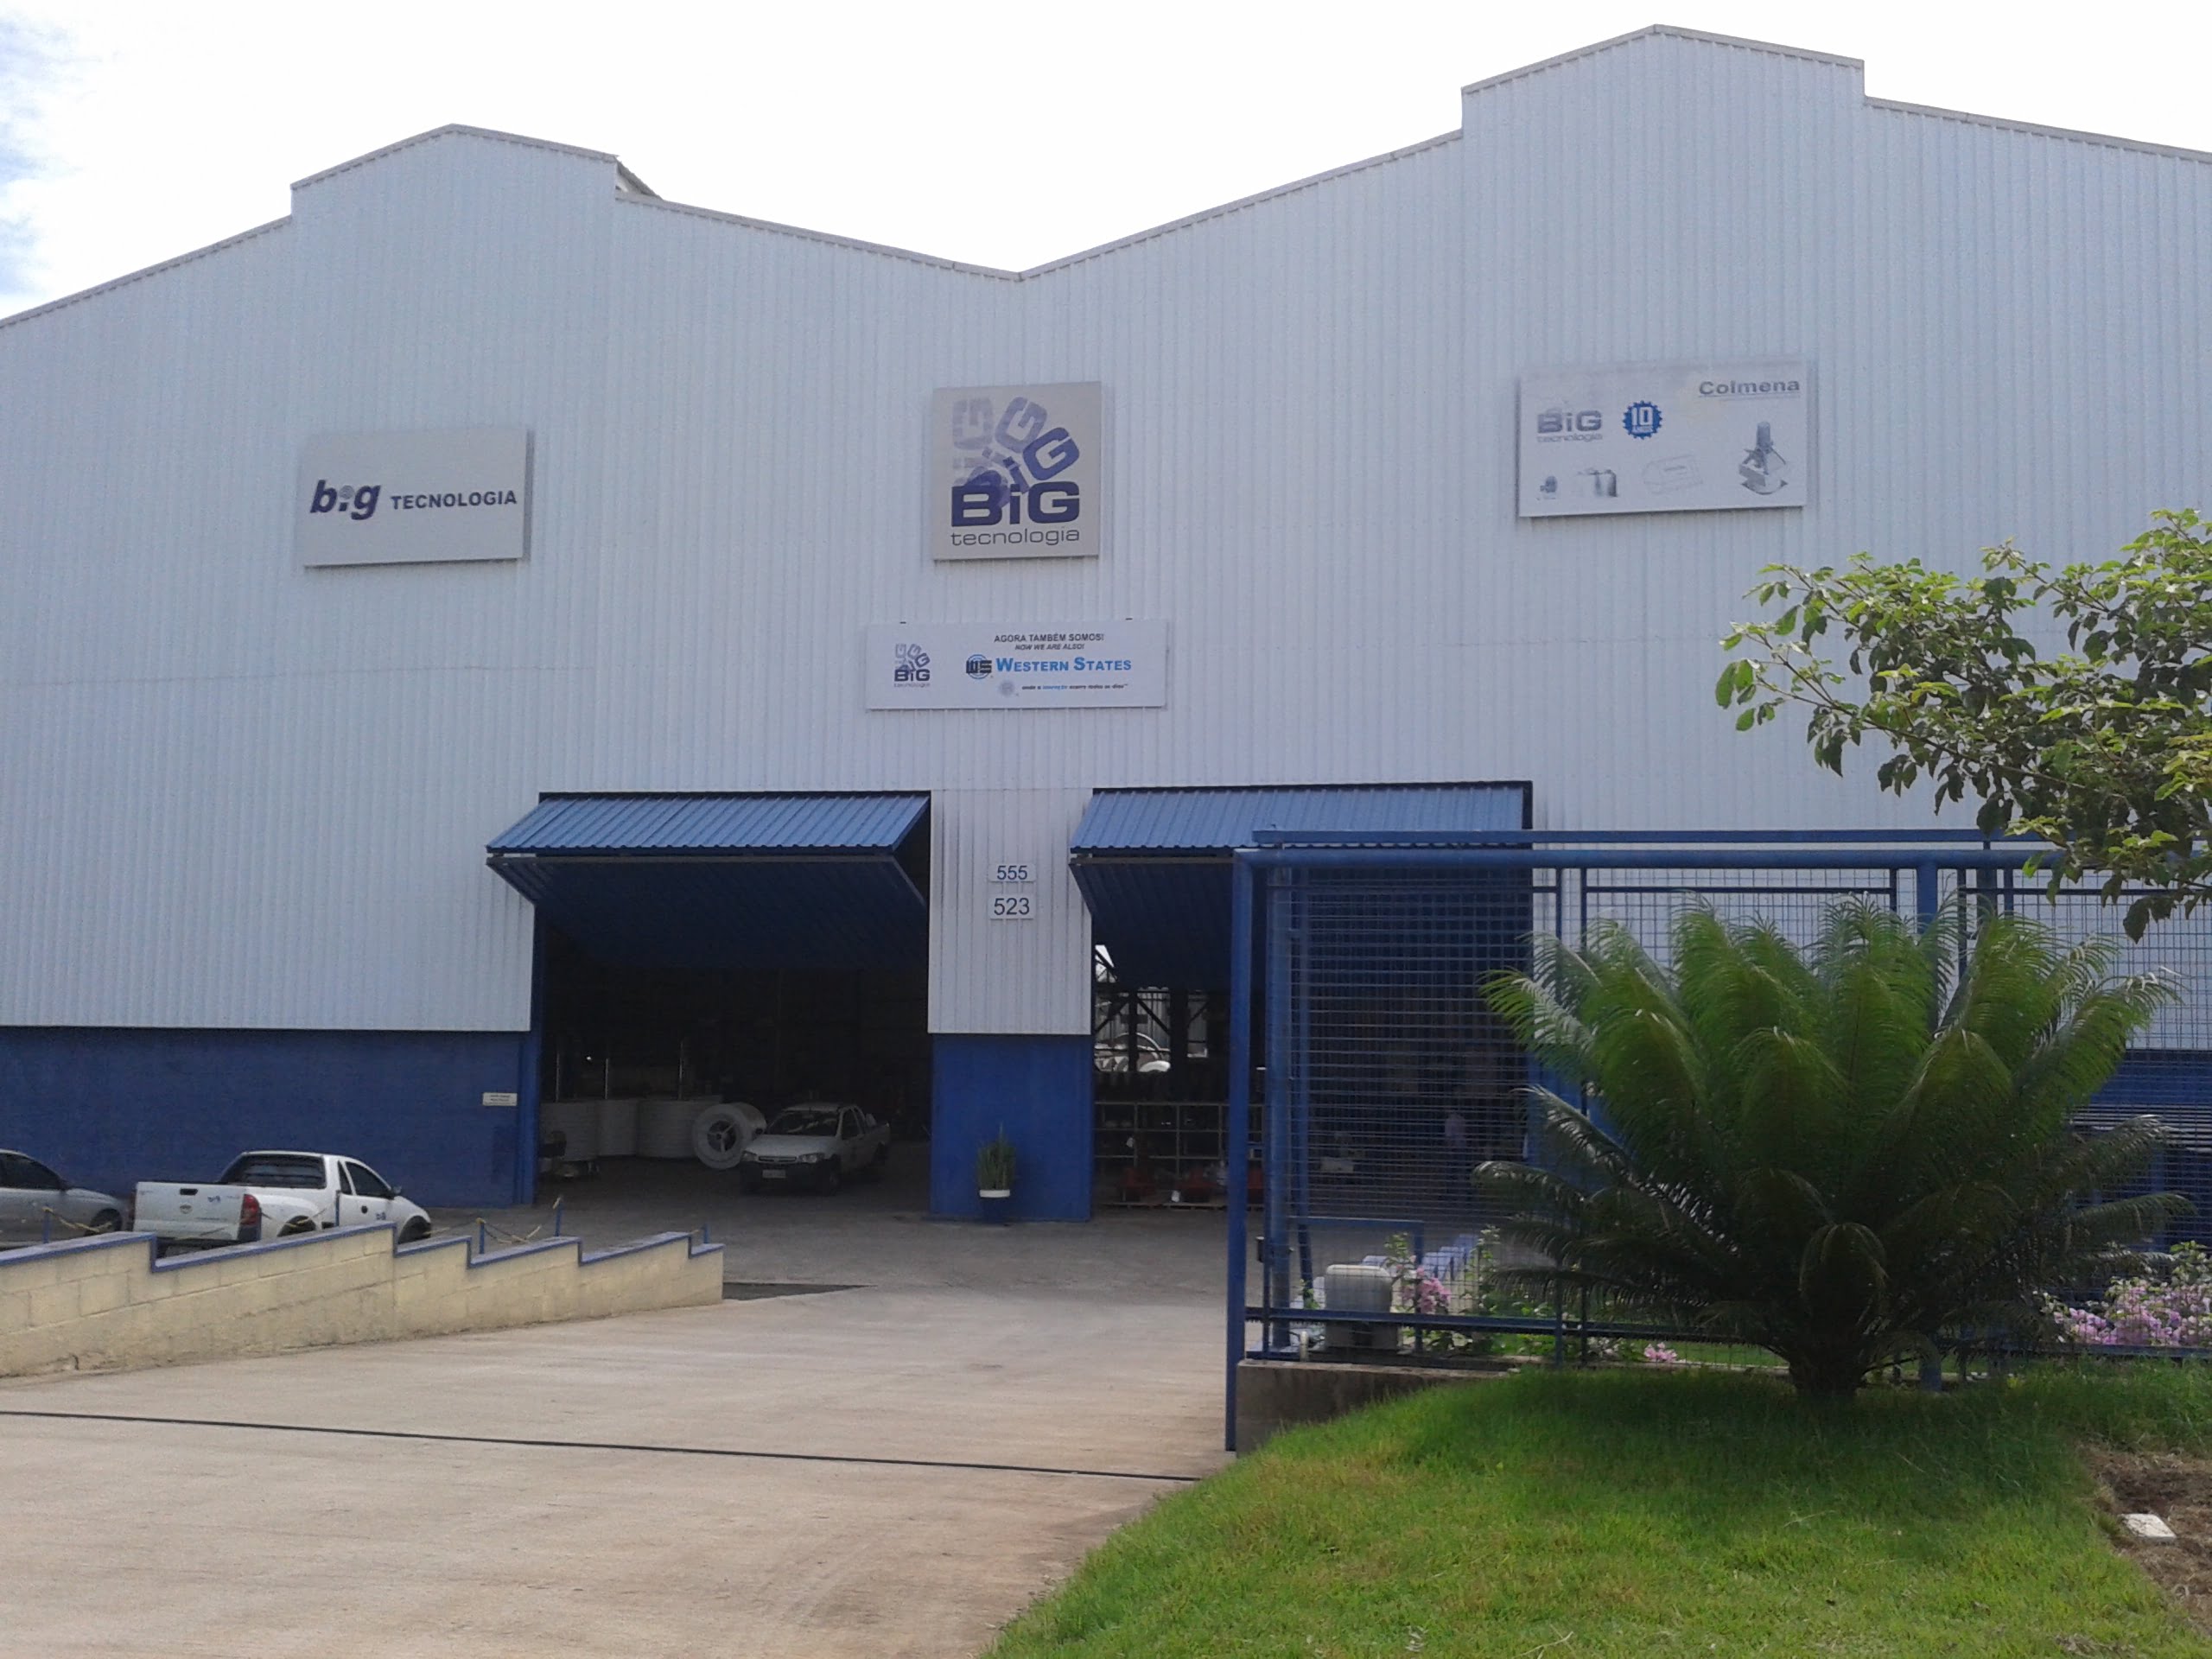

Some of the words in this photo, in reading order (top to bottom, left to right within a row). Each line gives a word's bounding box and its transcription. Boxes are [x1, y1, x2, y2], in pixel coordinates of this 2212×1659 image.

[1699, 380, 1800, 395] Colmena
[1537, 410, 1602, 434] BiG
[391, 490, 518, 510] TECNOLOGIA
[951, 480, 1080, 527] BiG
[950, 527, 1080, 546] tecnologia
[994, 634, 1027, 643] AGORA
[1028, 632, 1066, 642] TAMBÉM
[995, 658, 1069, 672] WESTERN
[1073, 657, 1132, 671] STATES
[996, 865, 1028, 880] 555
[994, 897, 1030, 916] 523
